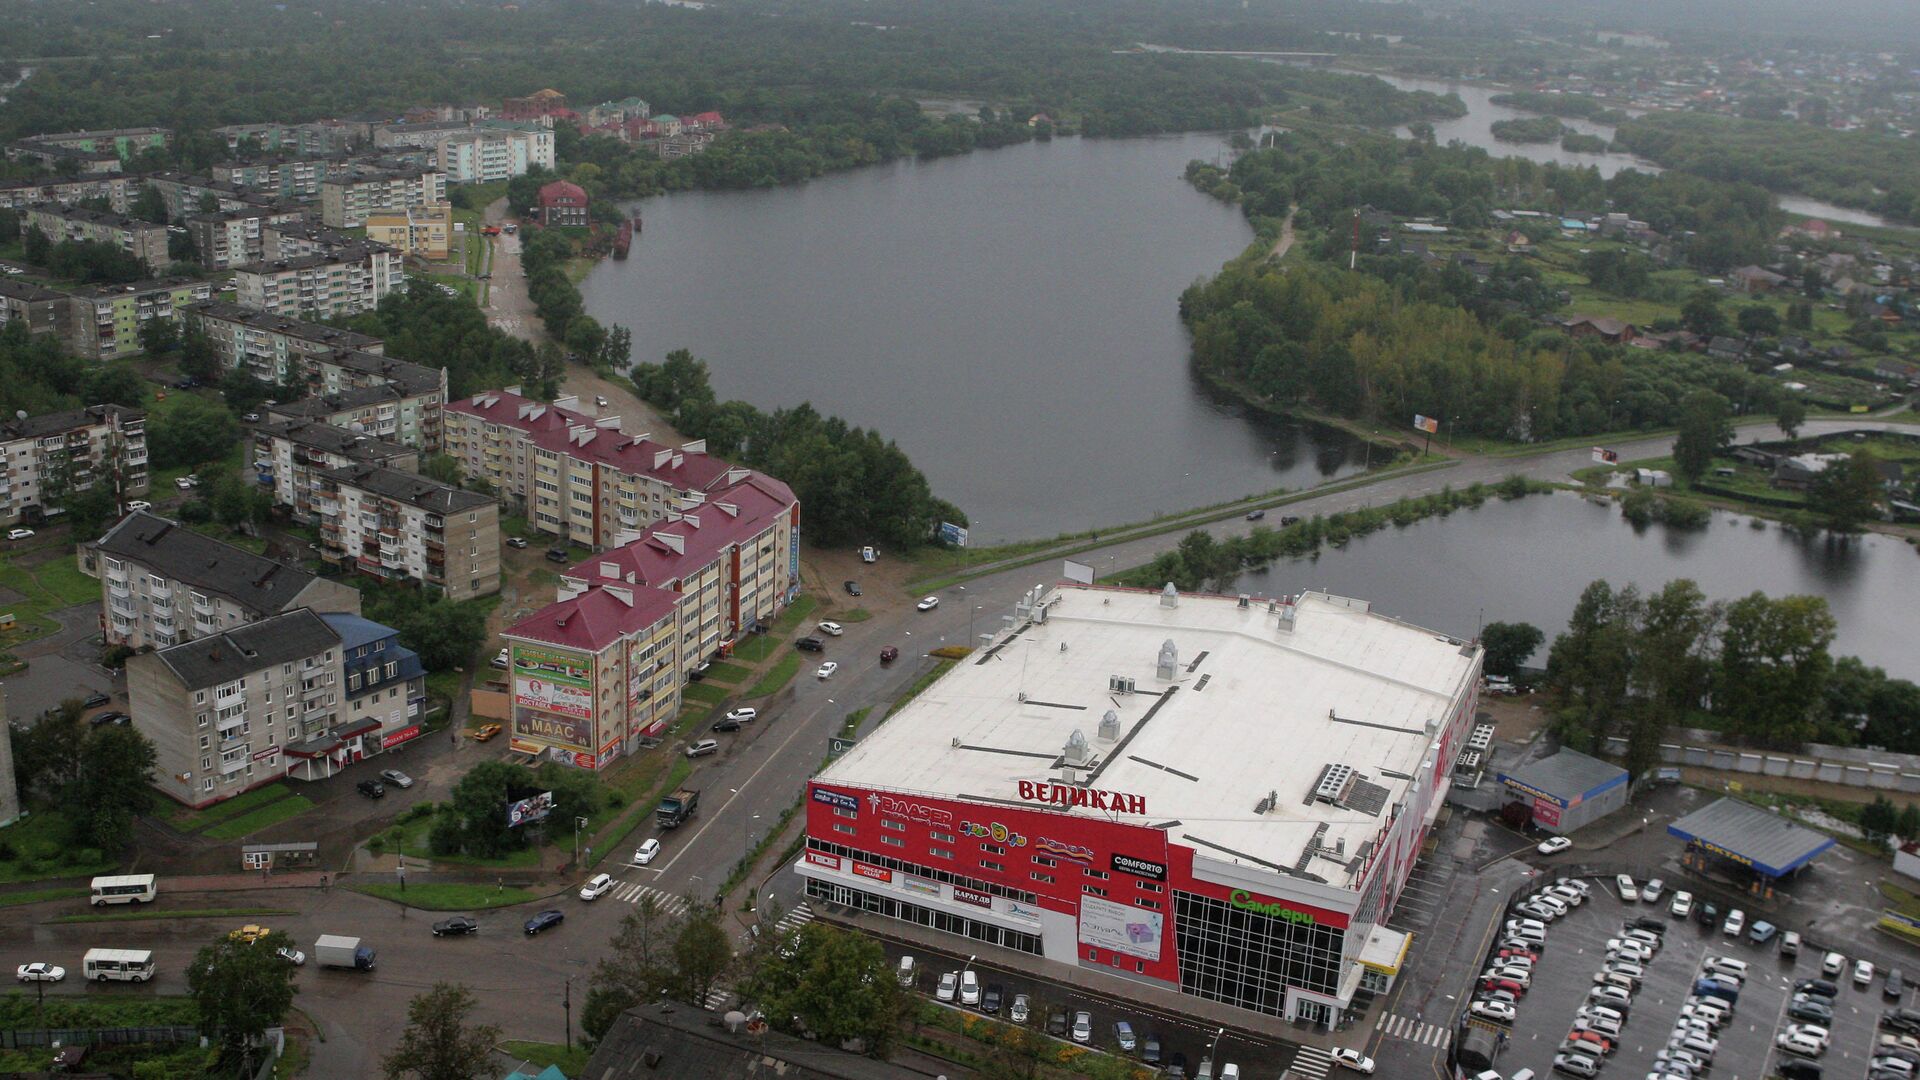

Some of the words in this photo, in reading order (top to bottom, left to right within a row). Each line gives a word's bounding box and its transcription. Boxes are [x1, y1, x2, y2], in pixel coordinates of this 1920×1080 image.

[520, 698, 552, 710] ДОСТАВКА
[531, 719, 574, 738] МААС
[1018, 780, 1147, 815] ВЕЛИКАН
[1504, 778, 1562, 805] АВТОМОЙКА
[1705, 843, 1753, 866] ОКТАН
[857, 864, 888, 876] CONCEPT
[863, 870, 880, 878] CLUB
[1114, 856, 1163, 874] COMFORTO
[954, 889, 979, 902] КАРАТ
[978, 895, 991, 905] ДВ
[1230, 889, 1314, 925] Самбери
